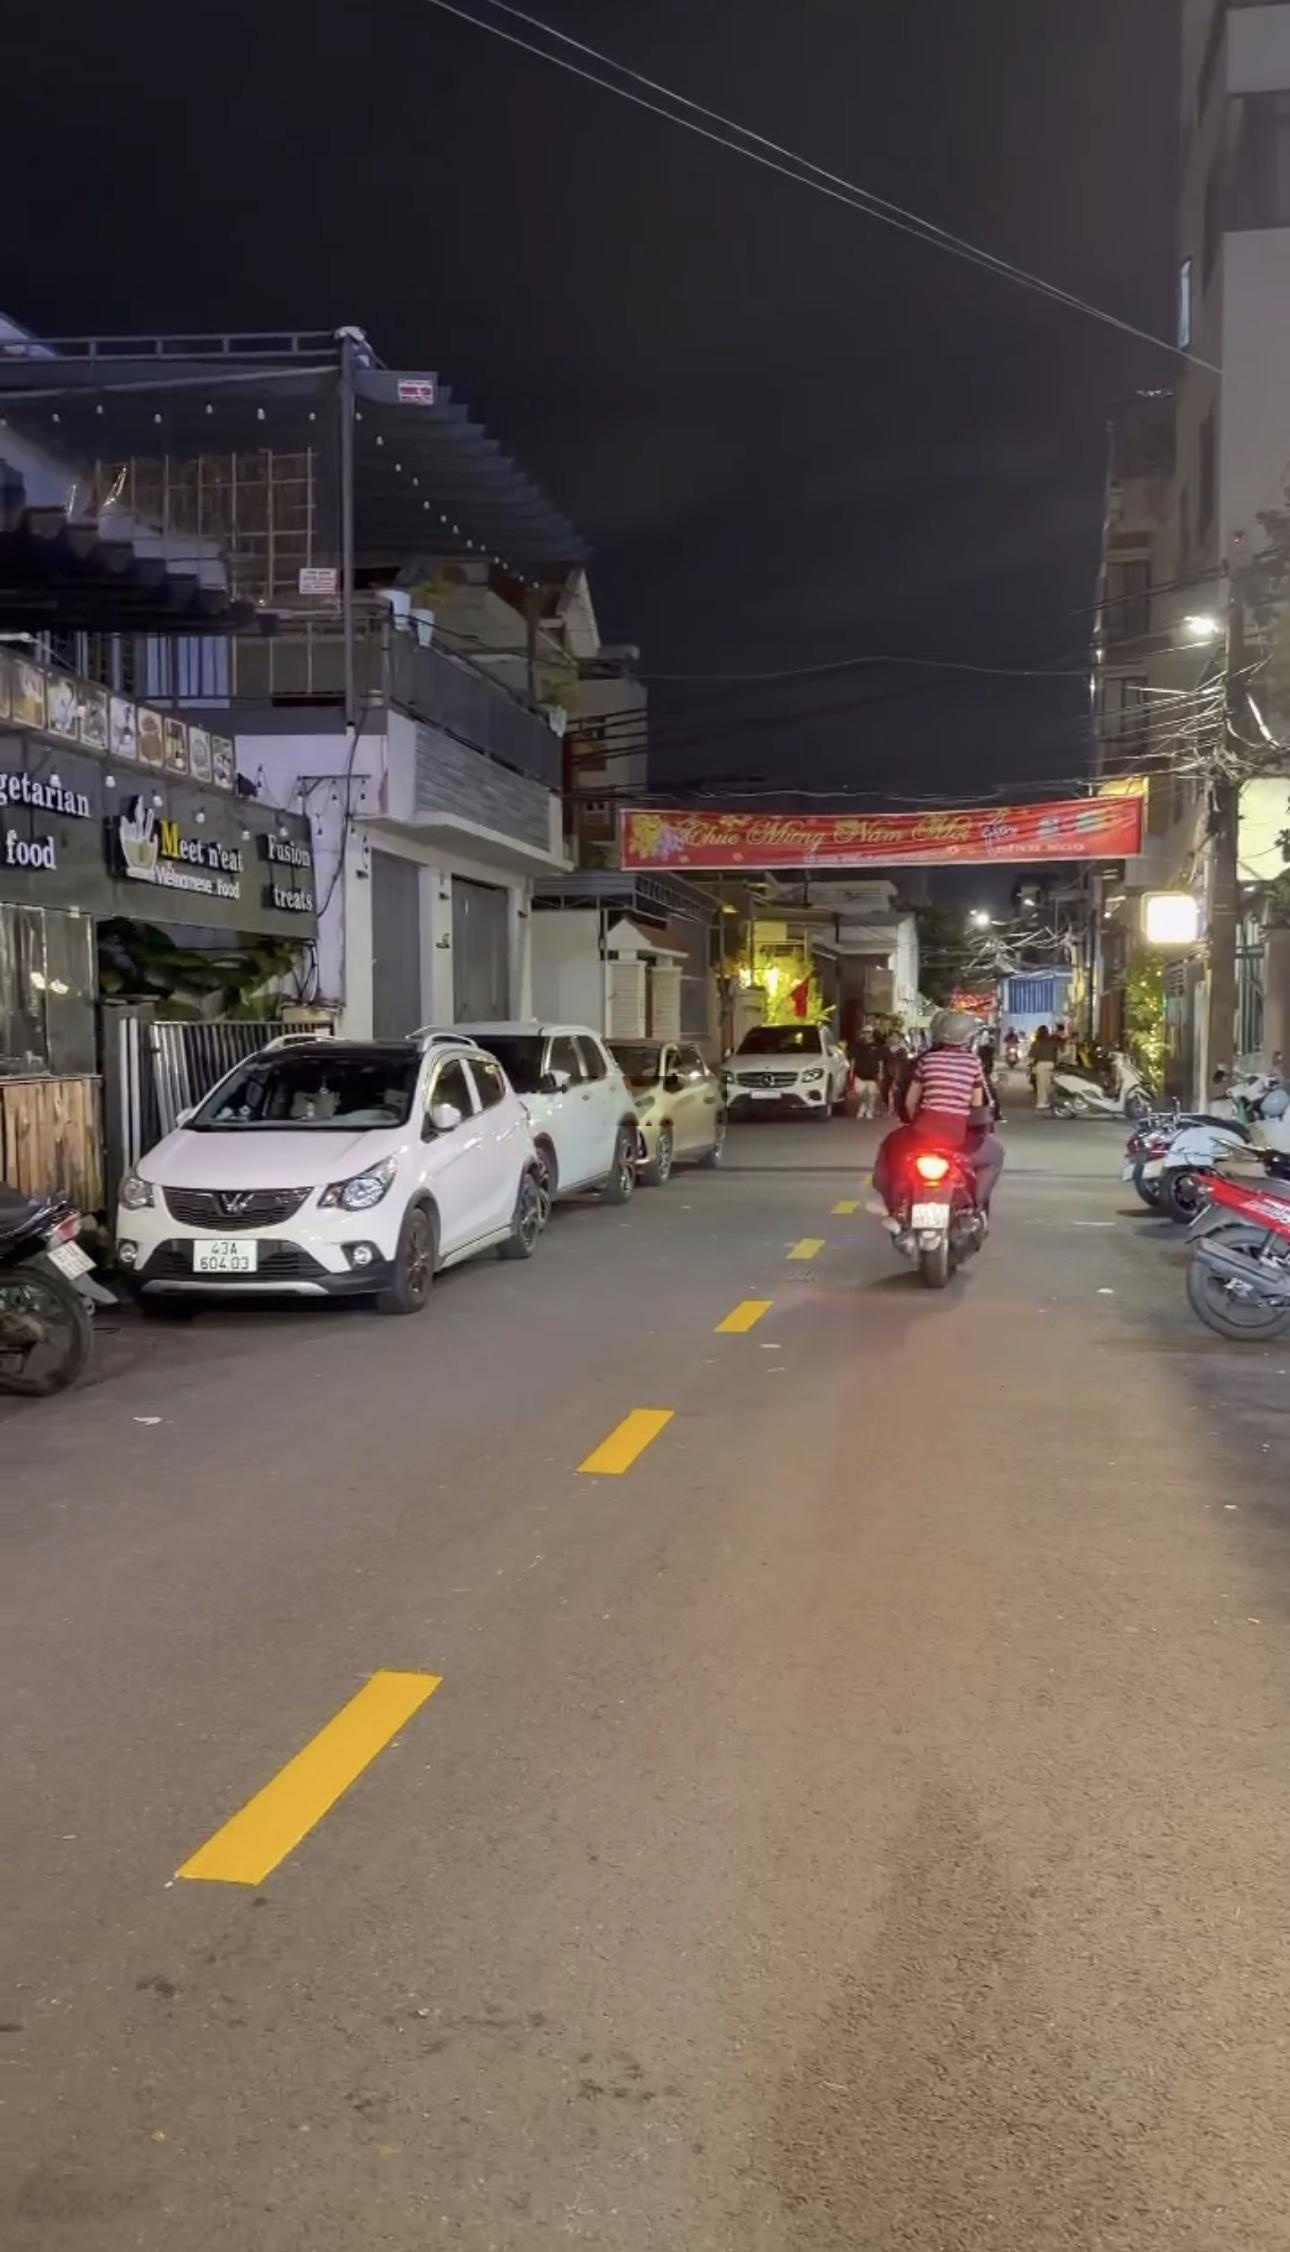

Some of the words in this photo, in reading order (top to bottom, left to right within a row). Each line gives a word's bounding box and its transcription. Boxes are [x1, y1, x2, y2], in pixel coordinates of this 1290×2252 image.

[6, 829, 57, 870] food
[160, 819, 204, 864] Meet
[208, 842, 243, 873] n'eat
[267, 834, 311, 867] Fusion
[217, 878, 240, 899] Food
[273, 887, 312, 911] treats
[211, 1242, 238, 1255] 43A
